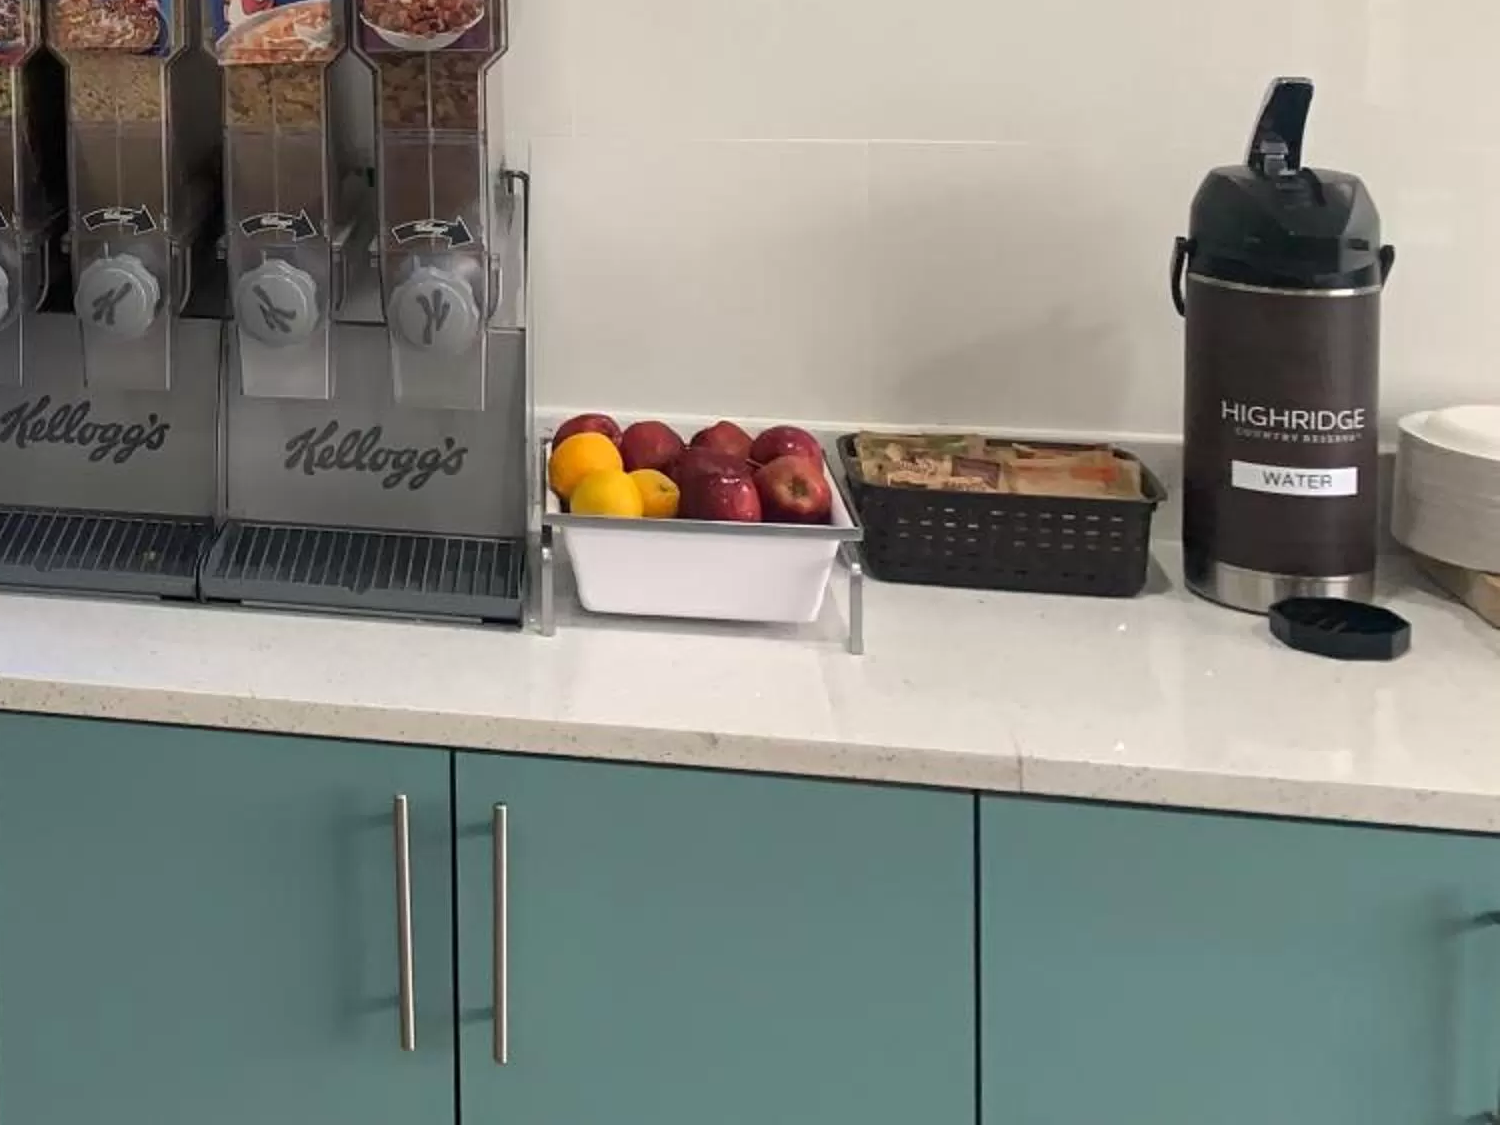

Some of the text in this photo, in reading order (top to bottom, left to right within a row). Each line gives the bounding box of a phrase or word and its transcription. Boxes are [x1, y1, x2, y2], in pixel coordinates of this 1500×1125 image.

[1221, 400, 1365, 431] HIGHRIDGE
[284, 420, 468, 491] Kellogg's
[1262, 471, 1333, 489] WATER
